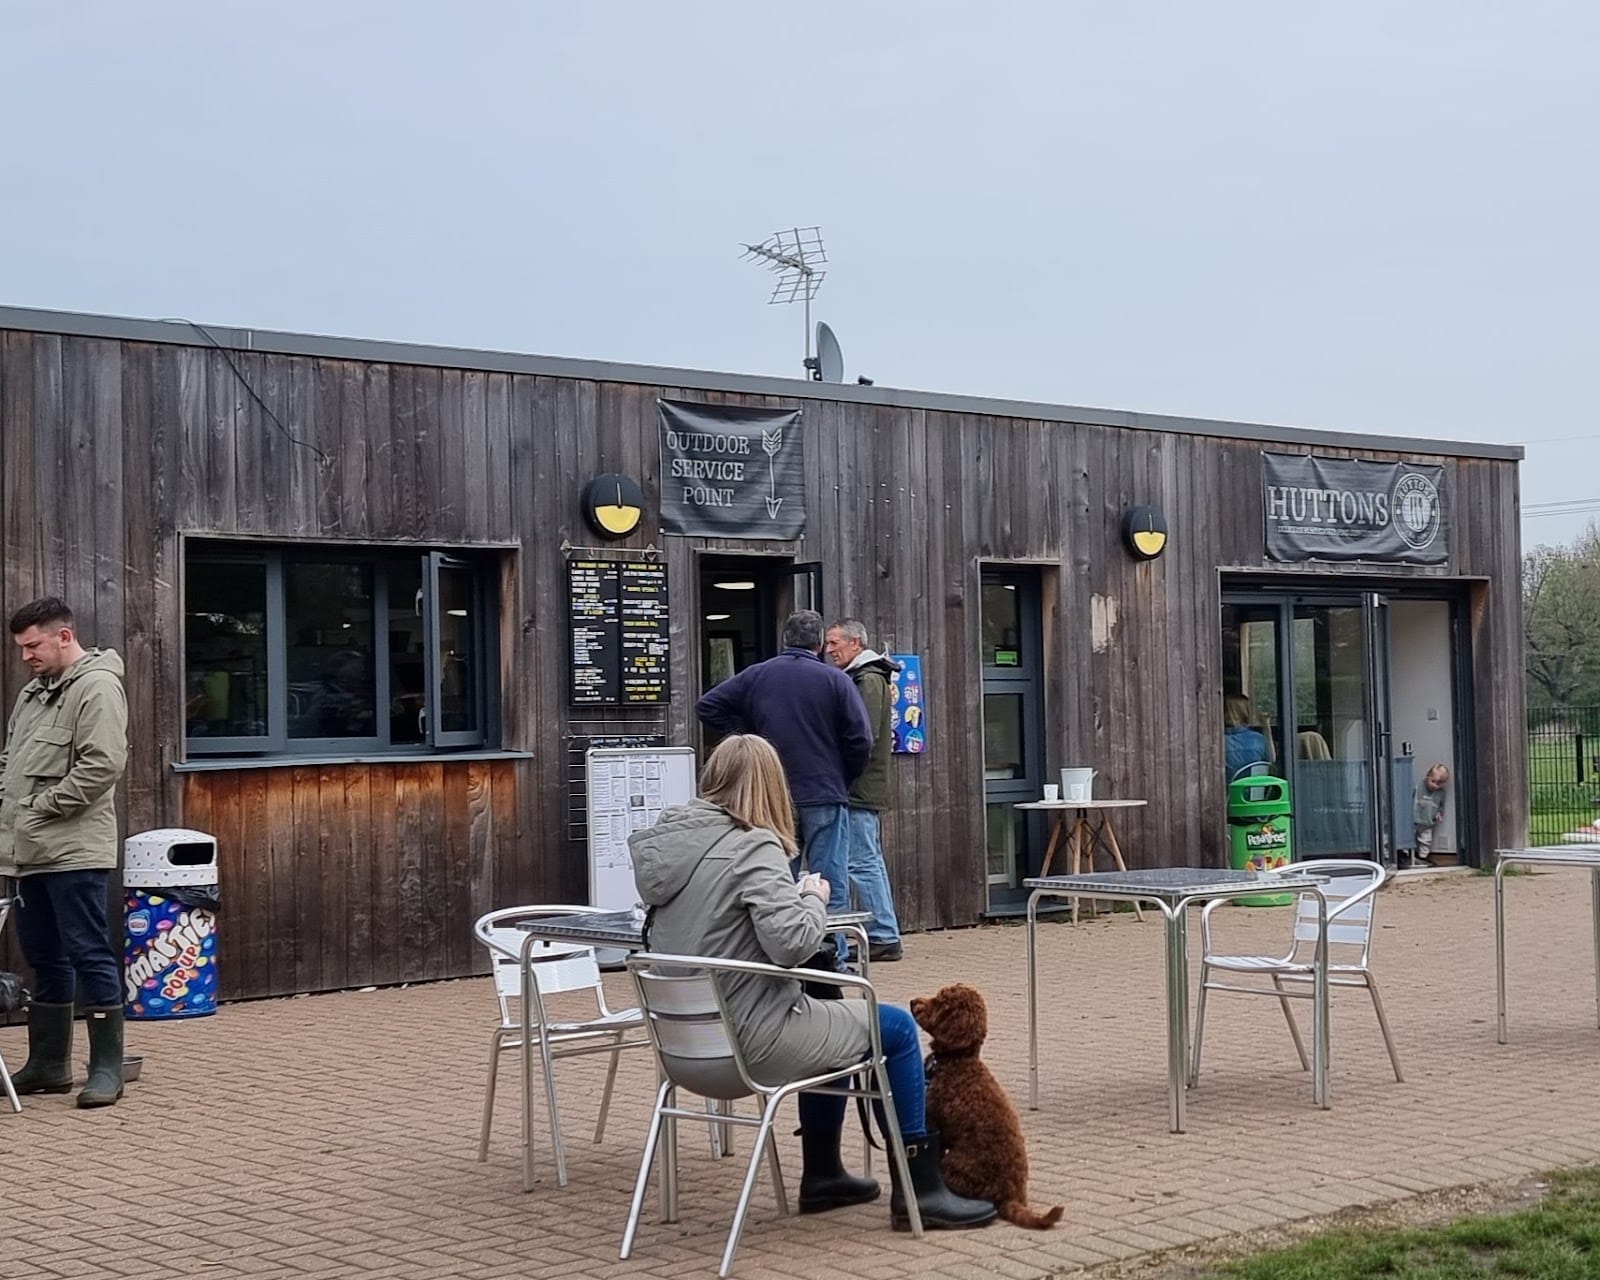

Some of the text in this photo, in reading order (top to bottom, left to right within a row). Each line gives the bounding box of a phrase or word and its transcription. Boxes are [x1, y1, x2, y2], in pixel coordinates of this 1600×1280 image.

[666, 430, 750, 455] OUTDOOR
[671, 458, 745, 481] SERVICE
[682, 486, 734, 507] POINT
[1398, 479, 1435, 502] HUTTONS
[1268, 486, 1389, 526] HUTTONS
[161, 945, 199, 999] POP UP
